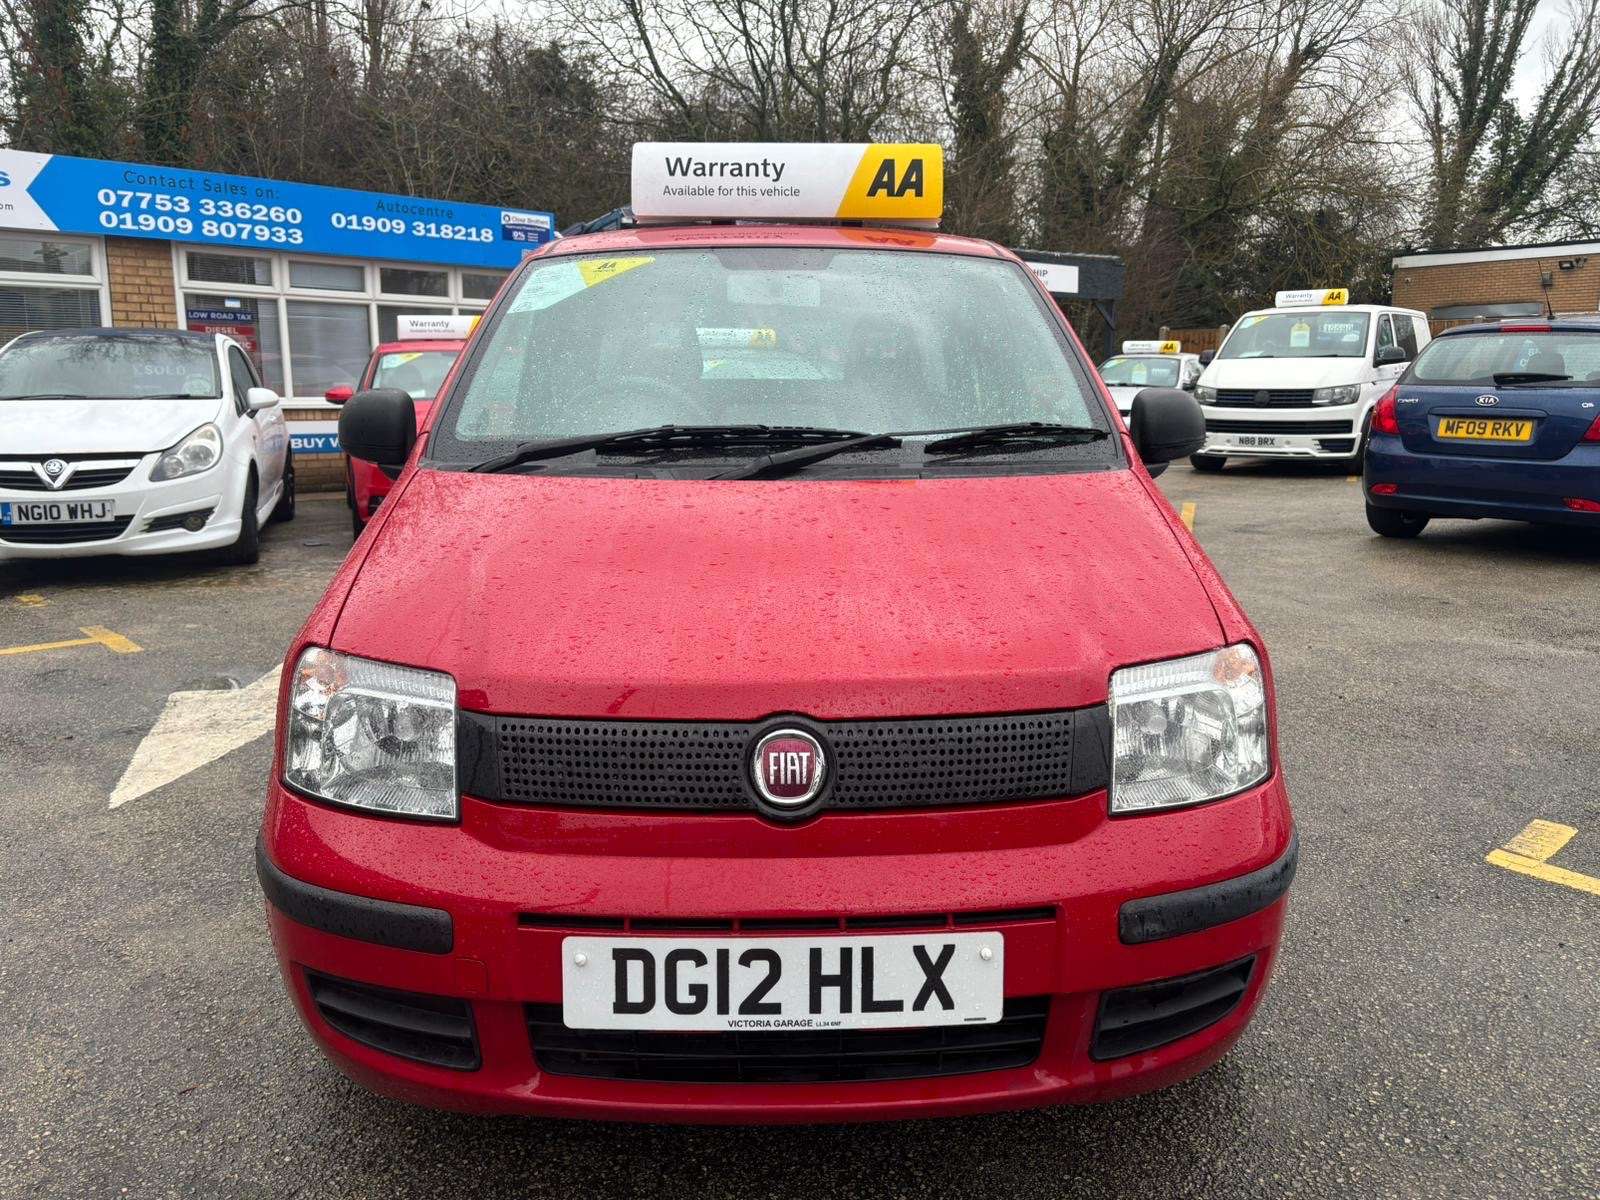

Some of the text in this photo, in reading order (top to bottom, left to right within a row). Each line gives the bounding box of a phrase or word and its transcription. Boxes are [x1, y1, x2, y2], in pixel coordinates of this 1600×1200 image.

[666, 156, 785, 182] Warranty
[866, 158, 923, 198] AA
[123, 170, 279, 199] Contact Sales on:
[662, 185, 800, 198] Available for this vehicle
[97, 188, 303, 224] 07753 336260
[376, 200, 454, 219] Autocentre
[99, 211, 304, 244] 01909 807933
[331, 213, 494, 243] 01909 318218
[1328, 292, 1342, 301] AA
[210, 312, 235, 321] ROAD
[237, 313, 252, 321] TAX
[409, 320, 450, 329] Warranty
[205, 325, 240, 335] DIESEL
[1478, 395, 1495, 405] KIA
[1444, 420, 1525, 437] MF09 RKV
[291, 437, 325, 449] BUY
[17, 502, 107, 521] NG10 WHJ
[769, 752, 811, 785] FIAT
[612, 943, 957, 1015] DG12 HLX
[728, 1019, 772, 1028] VICTORIA
[773, 1019, 813, 1028] GARAGE
